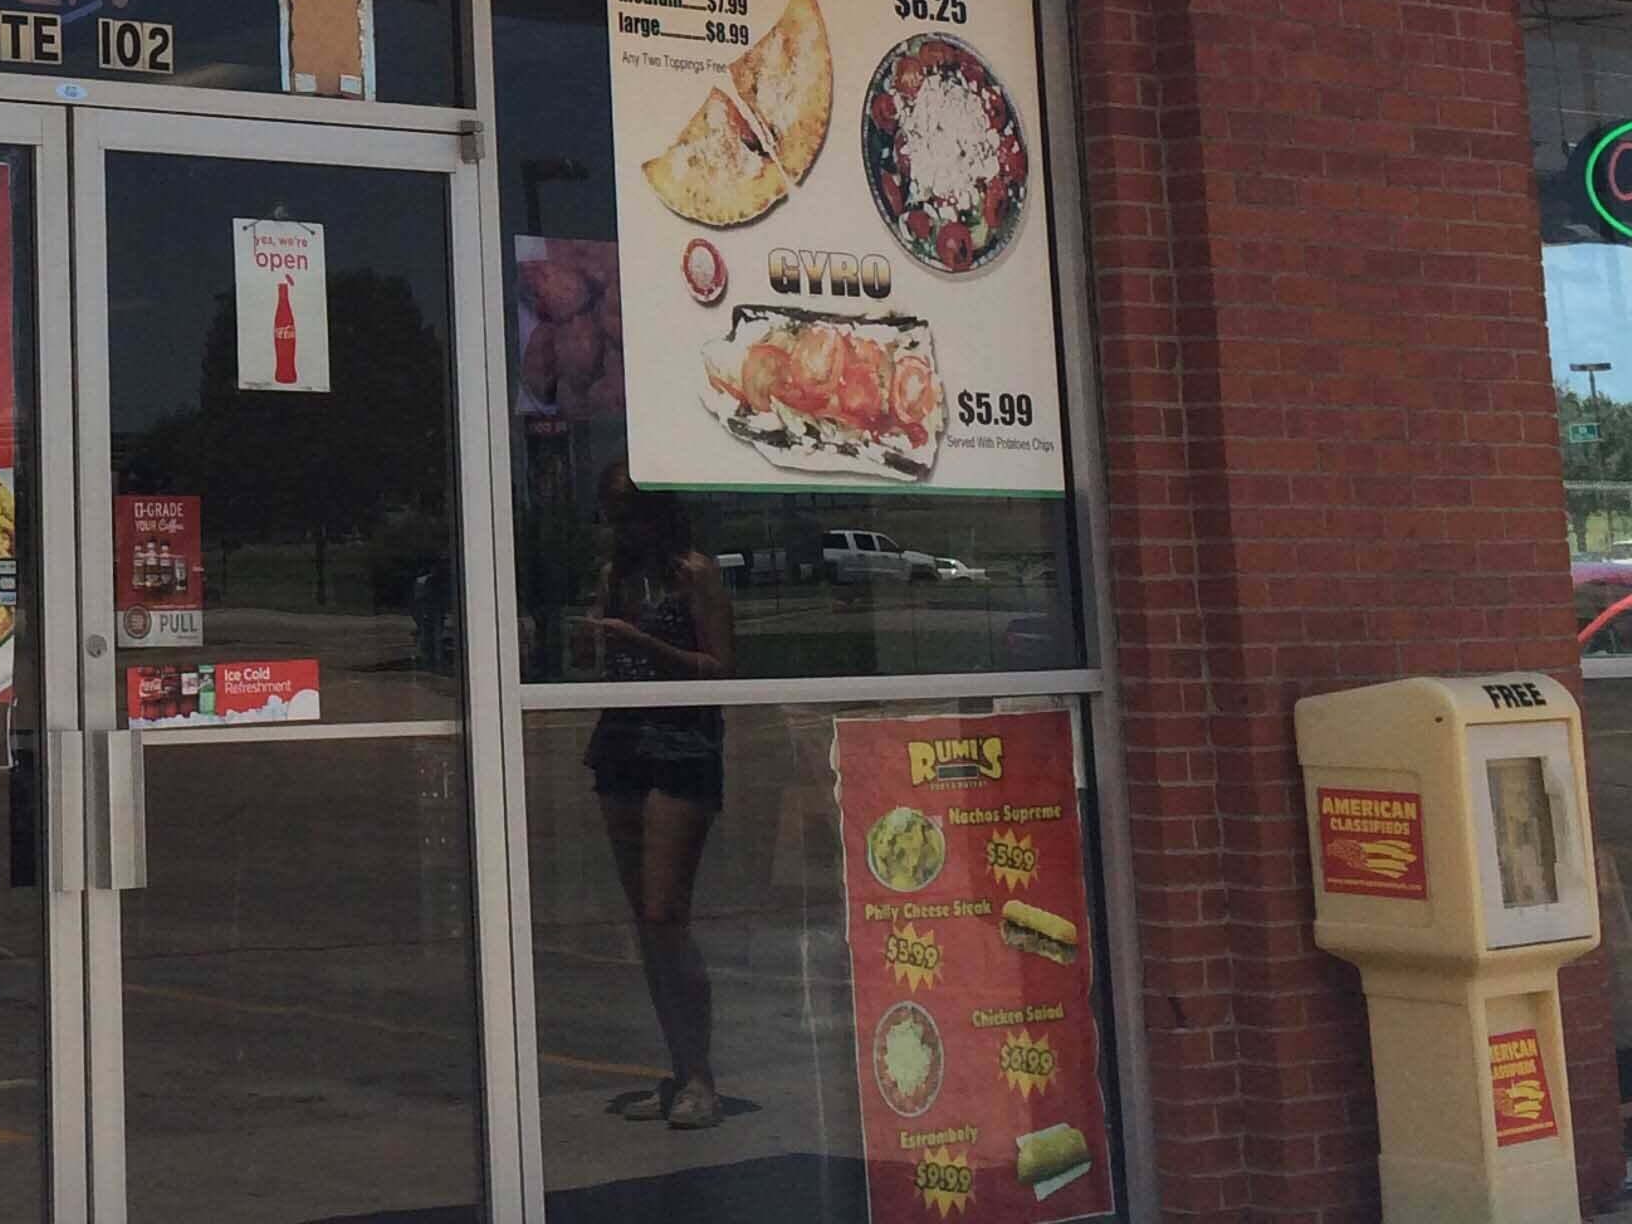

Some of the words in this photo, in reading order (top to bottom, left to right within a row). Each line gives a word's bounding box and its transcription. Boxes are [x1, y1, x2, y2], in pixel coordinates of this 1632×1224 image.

[100, 20, 170, 70] 102
[621, 51, 640, 68] Any
[642, 51, 662, 68] Two
[663, 54, 705, 74] Toppings
[706, 58, 728, 74] Free
[256, 251, 308, 272] open
[768, 248, 892, 299] GYRO
[958, 390, 1033, 427] $5.99
[160, 613, 198, 633] PULL
[224, 668, 241, 682] Ice
[243, 666, 271, 681] Cold
[224, 679, 292, 695] Refreshment
[1481, 681, 1547, 709] FREE
[908, 736, 1003, 787] RUMI'S
[948, 807, 1000, 826] Nachos
[1003, 804, 1062, 825] Supreme
[1322, 796, 1417, 820] AMERICAN
[1329, 816, 1411, 836] CLASSIFIEDS
[986, 842, 1036, 873] $5.99
[903, 901, 950, 920] Cheese
[952, 898, 993, 918] Steak
[972, 1009, 1024, 1029] Chicken
[1026, 1003, 1065, 1023] Salad
